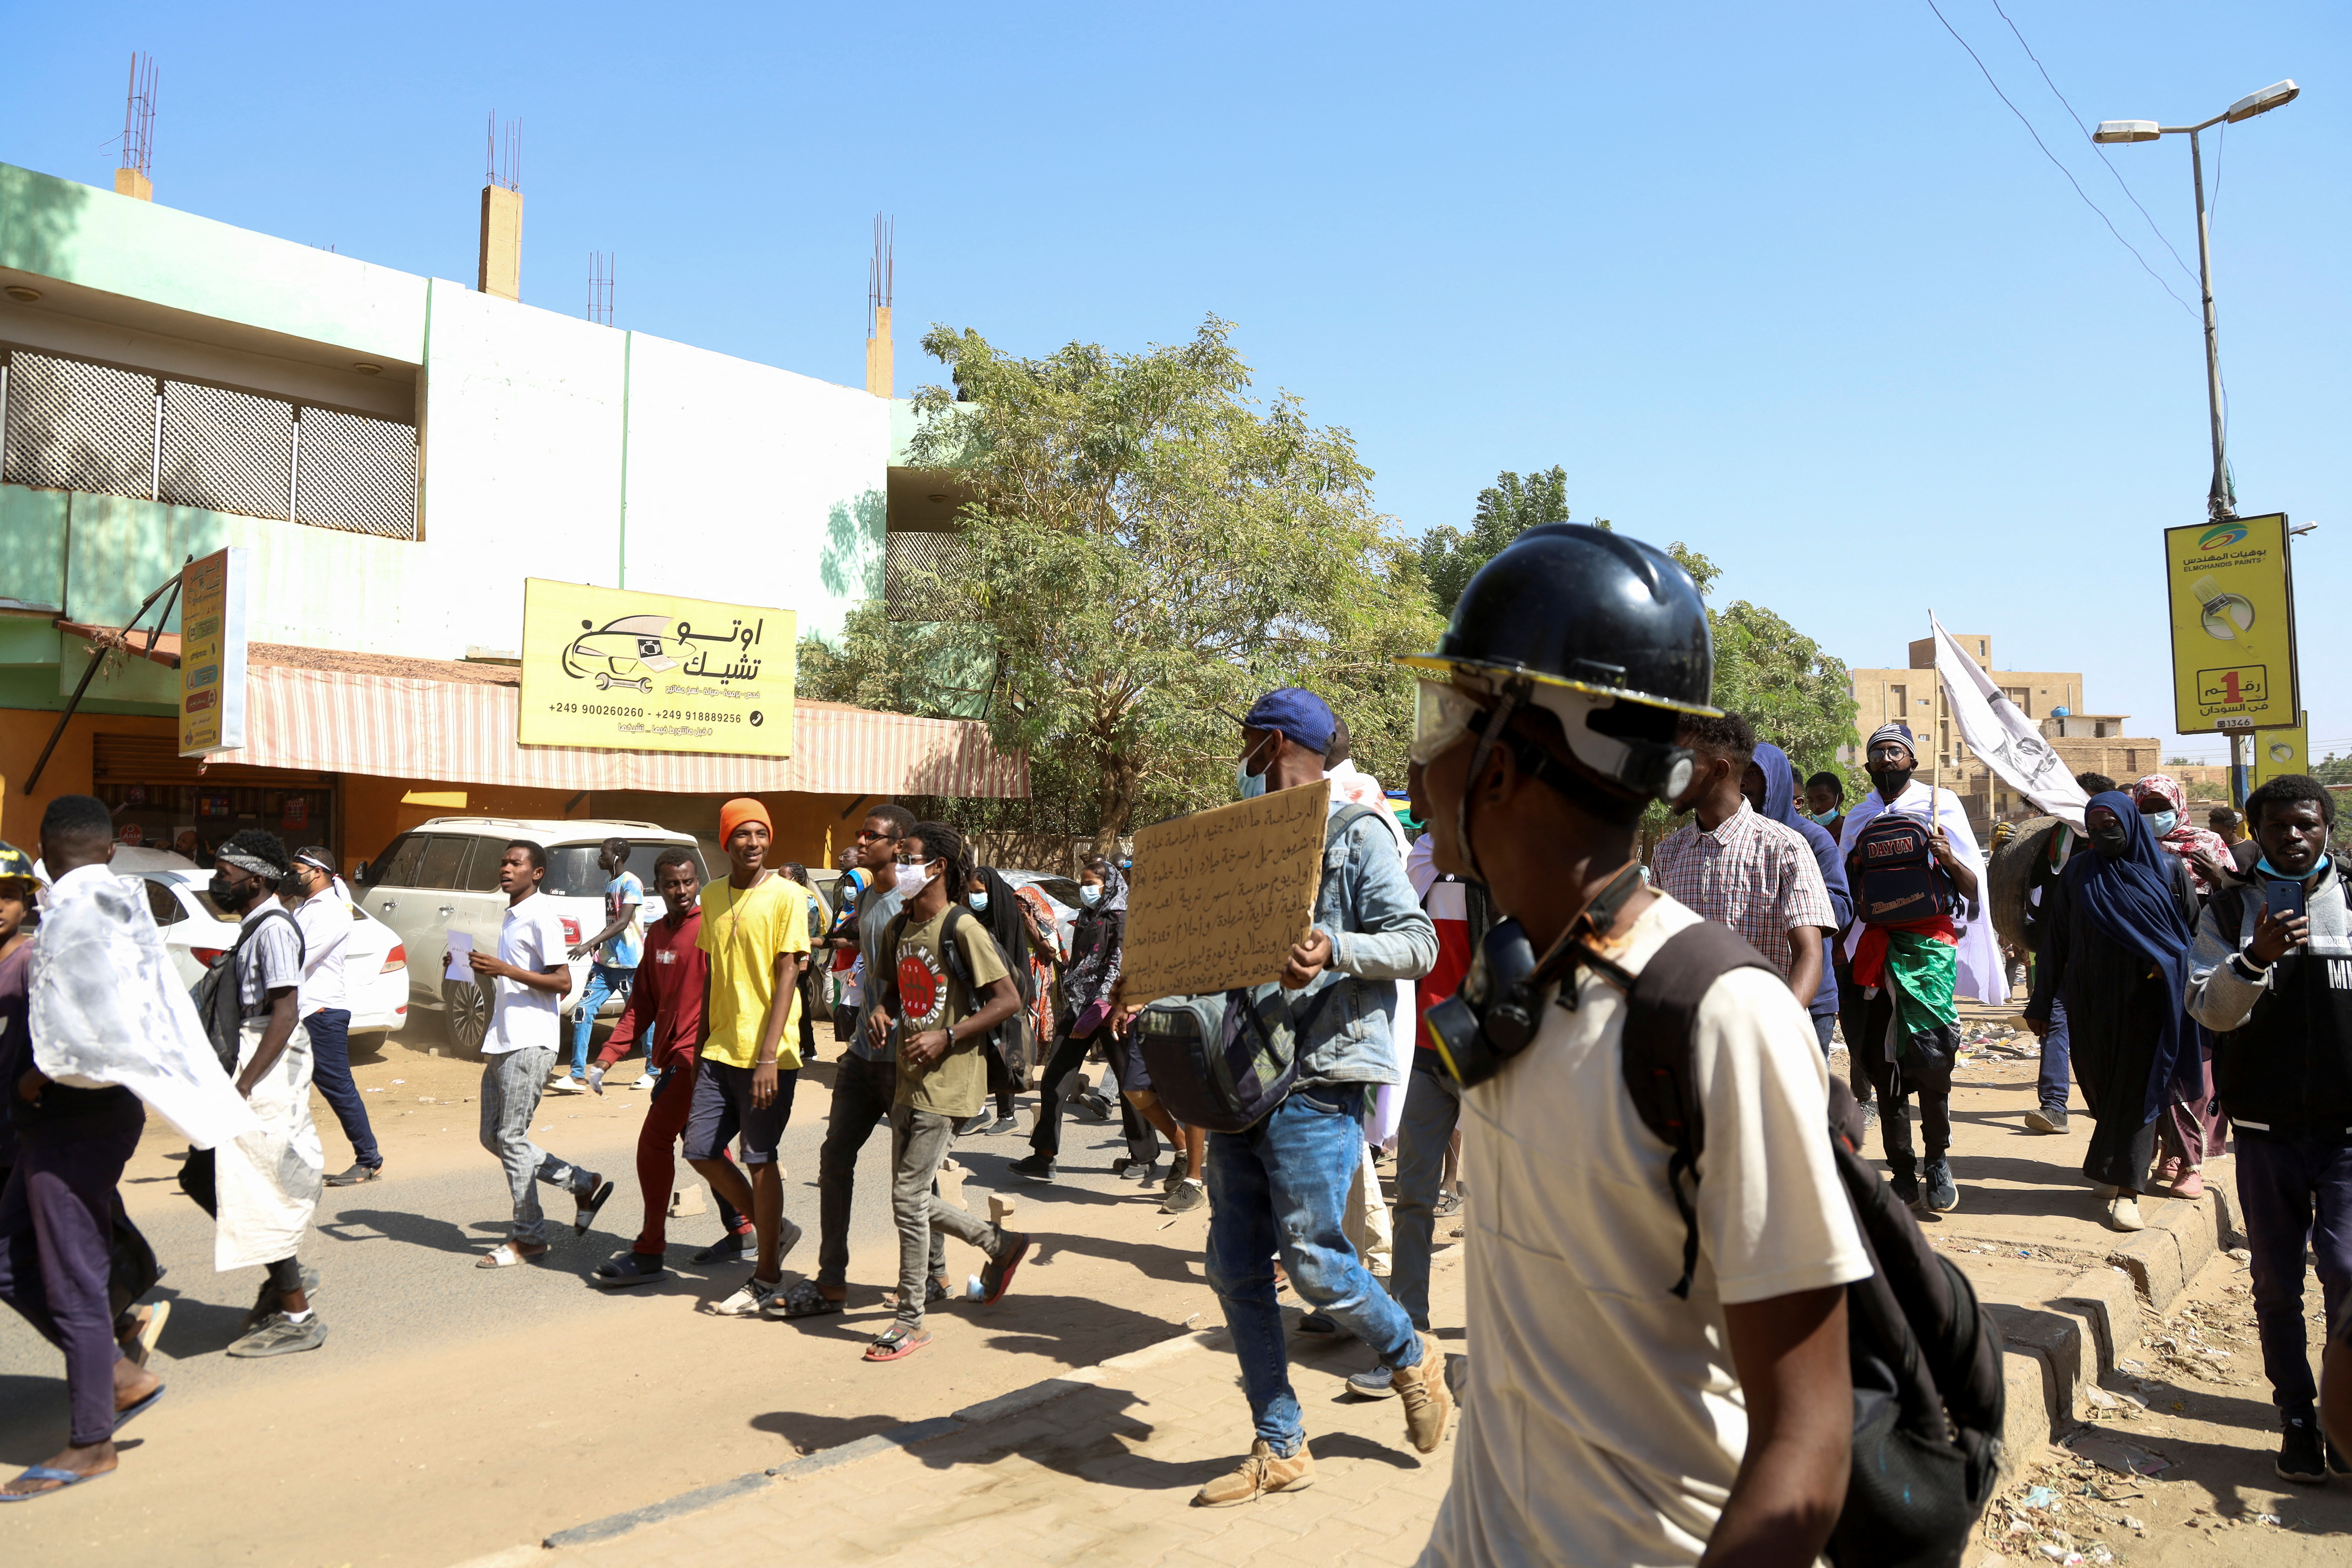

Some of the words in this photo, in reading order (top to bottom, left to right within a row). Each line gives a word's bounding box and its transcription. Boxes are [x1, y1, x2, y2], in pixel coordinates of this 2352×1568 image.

[2183, 553, 2228, 565] المهندس
[2184, 561, 2232, 572] ELMOHANDIS
[2234, 557, 2262, 566] PAINTS
[2230, 549, 2266, 558] بوهيات
[683, 651, 761, 685] تشيك
[665, 685, 685, 694] مفاتيح
[686, 686, 698, 695] نسخ
[703, 687, 719, 697] صيانة
[723, 689, 740, 699] برمجة
[745, 691, 760, 700] فحص
[2220, 671, 2244, 704] 1
[549, 702, 577, 713] +249
[582, 704, 643, 717] 900260260
[656, 710, 681, 719] +249
[685, 711, 741, 723] 918889256
[2200, 703, 2245, 716] السودان
[618, 722, 644, 734] تشيكها
[652, 724, 668, 735] فيها
[694, 727, 706, 737] قبل
[2227, 718, 2250, 727] 1346
[1228, 814, 1247, 832] 200
[1249, 804, 1260, 827] ما
[1264, 795, 1317, 834] الرصاصة
[1165, 823, 1199, 852] الرصاصة
[1204, 824, 1224, 842] جنيه
[1255, 845, 1273, 868] حمل
[1272, 836, 1309, 865] شهور
[1867, 836, 1913, 858] DAYUN
[1199, 850, 1219, 876] ميلاد
[1221, 848, 1251, 872] صرخة
[1153, 860, 1174, 890] خطوة
[1292, 859, 1313, 886] أول
[1238, 883, 1269, 905] مدرسة
[1268, 875, 1290, 902] يوم
[1281, 890, 1306, 919] عافية
[1871, 902, 1896, 915] Race
[1896, 898, 1911, 907] The
[1217, 904, 1243, 929] شهادة
[917, 946, 941, 975] MEN
[1204, 940, 1227, 972] ثورة
[921, 986, 948, 1029] PEDALS
